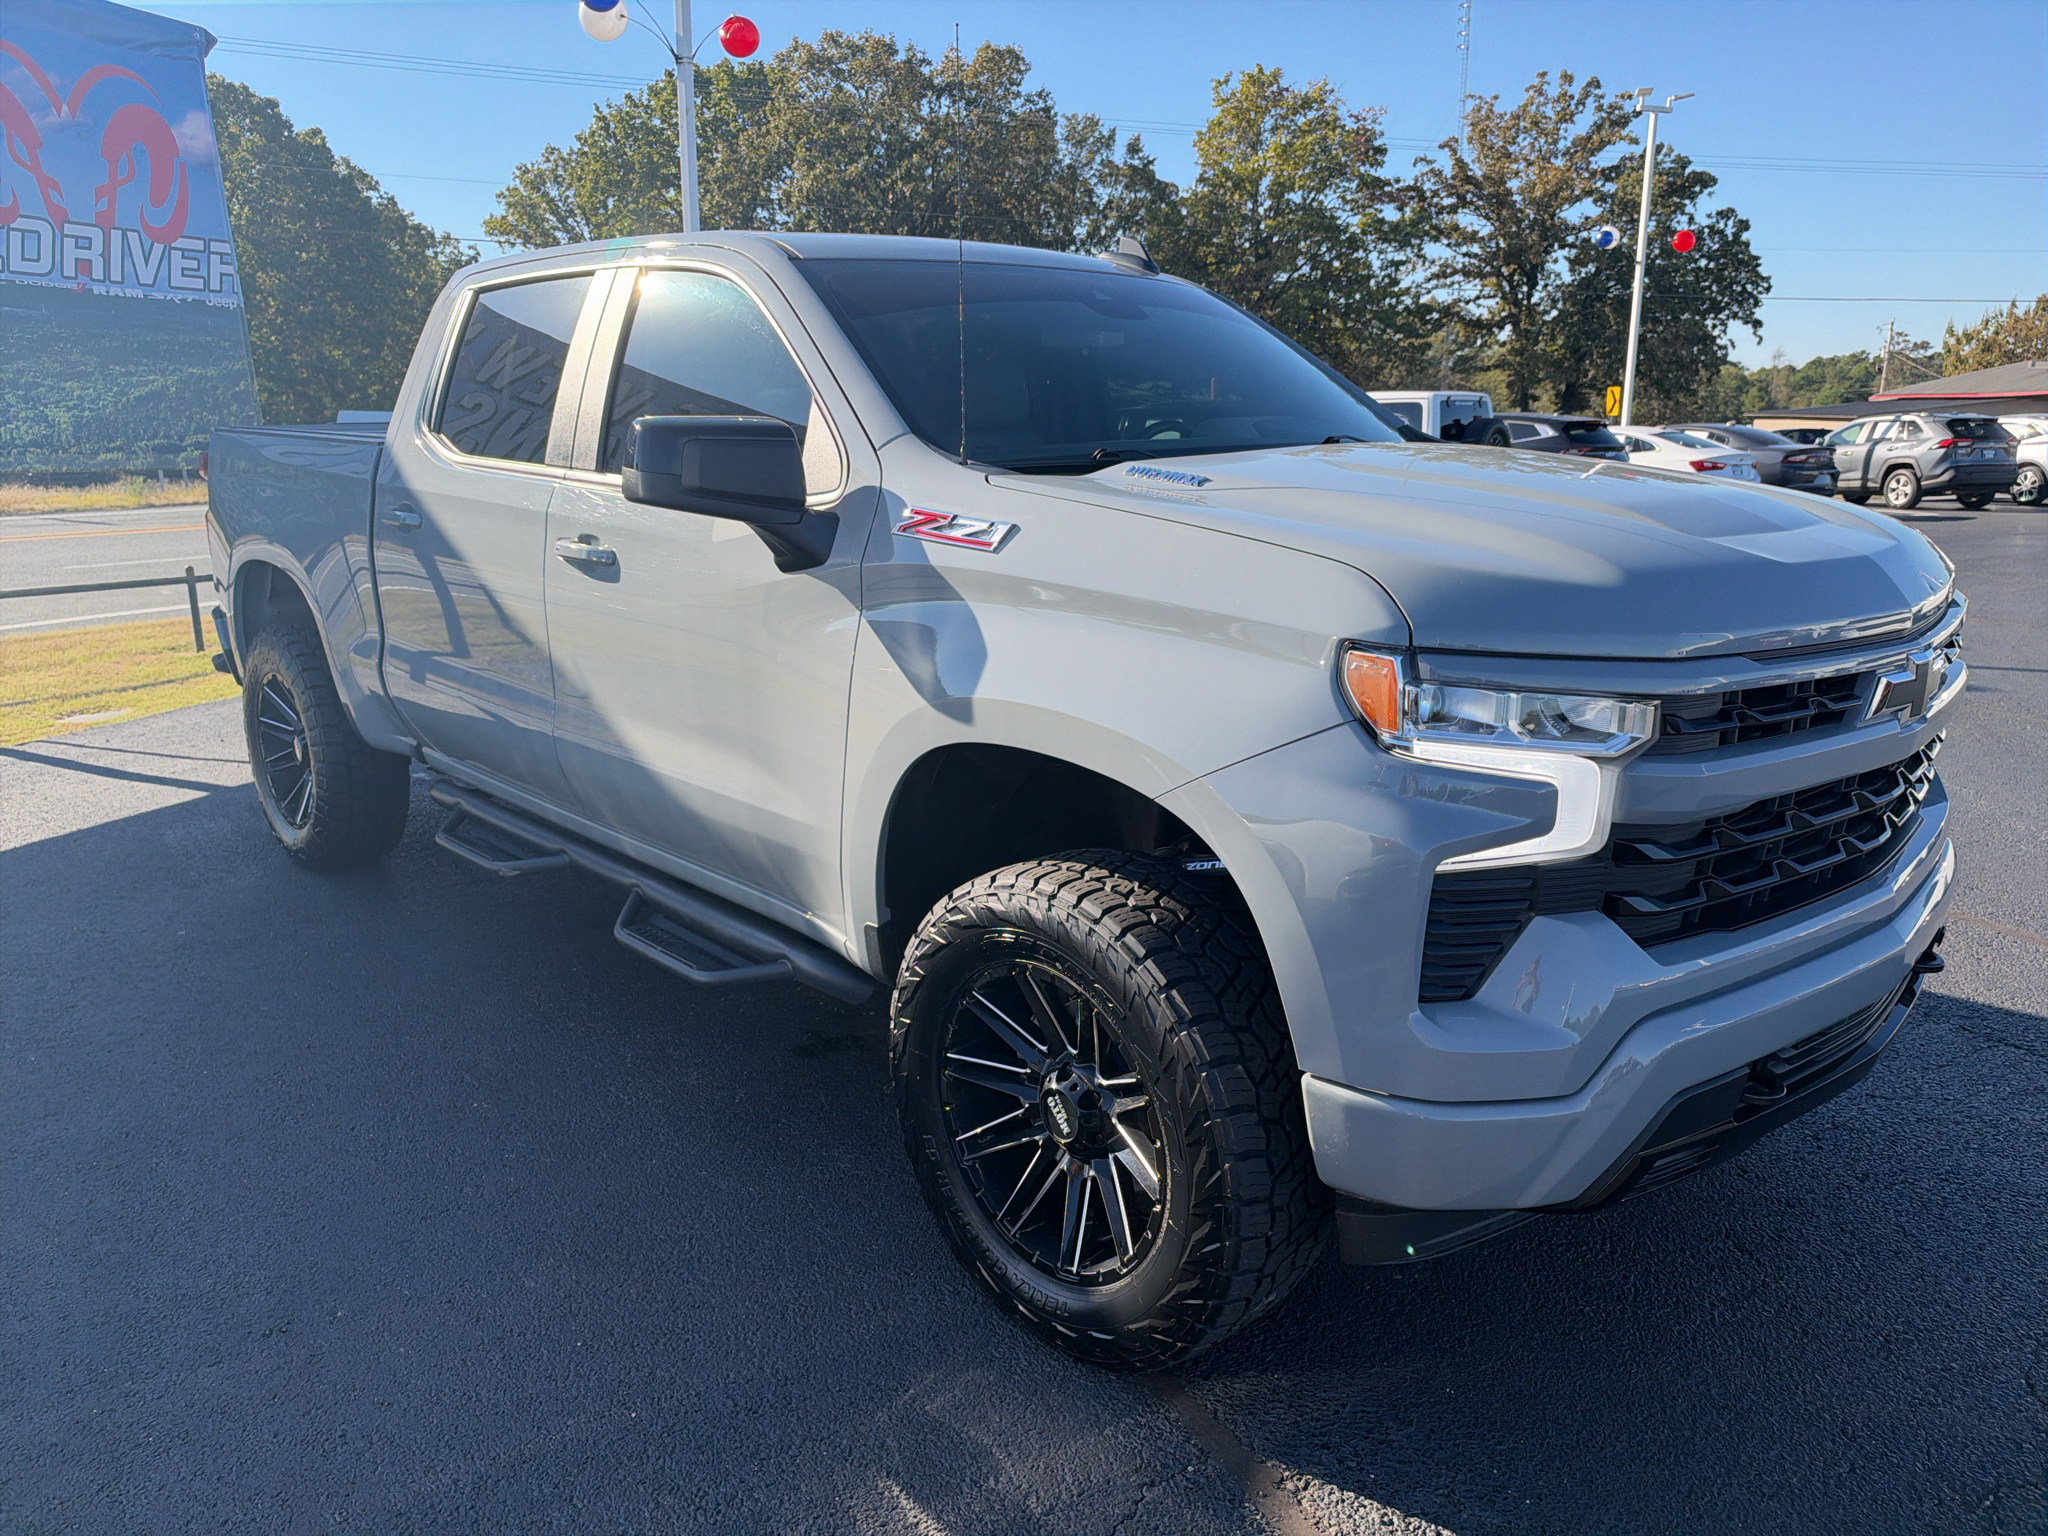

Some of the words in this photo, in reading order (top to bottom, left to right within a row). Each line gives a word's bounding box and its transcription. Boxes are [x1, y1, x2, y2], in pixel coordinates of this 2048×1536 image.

[92, 285, 144, 298] RAM
[1124, 465, 1212, 488] DURAMAX
[891, 505, 1020, 554] Z71
[1047, 1096, 1070, 1136] MOTO
